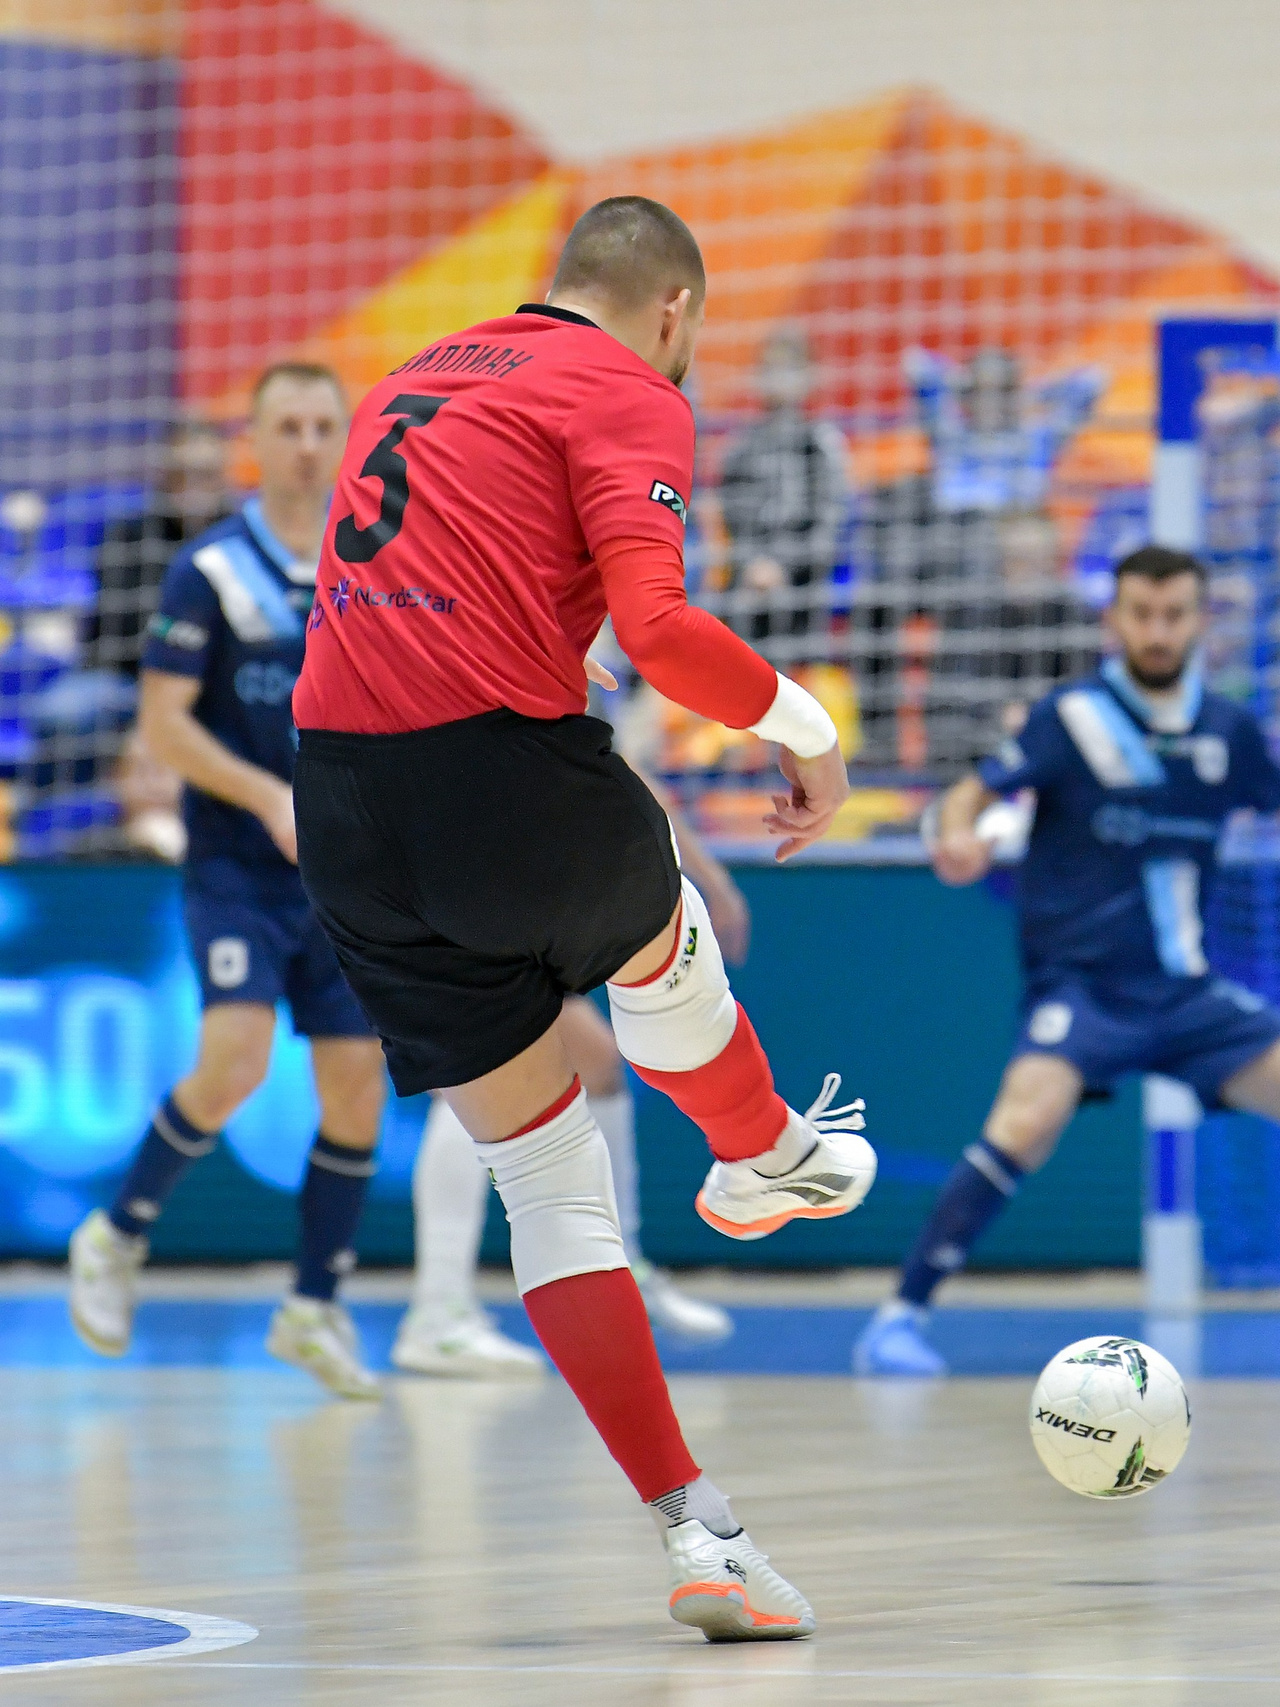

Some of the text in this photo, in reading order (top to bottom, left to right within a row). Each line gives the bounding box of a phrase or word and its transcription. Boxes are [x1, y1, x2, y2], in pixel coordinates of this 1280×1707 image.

[334, 394, 451, 563] 3
[354, 585, 457, 614] NordStar
[1035, 1407, 1118, 1443] DEMIX
